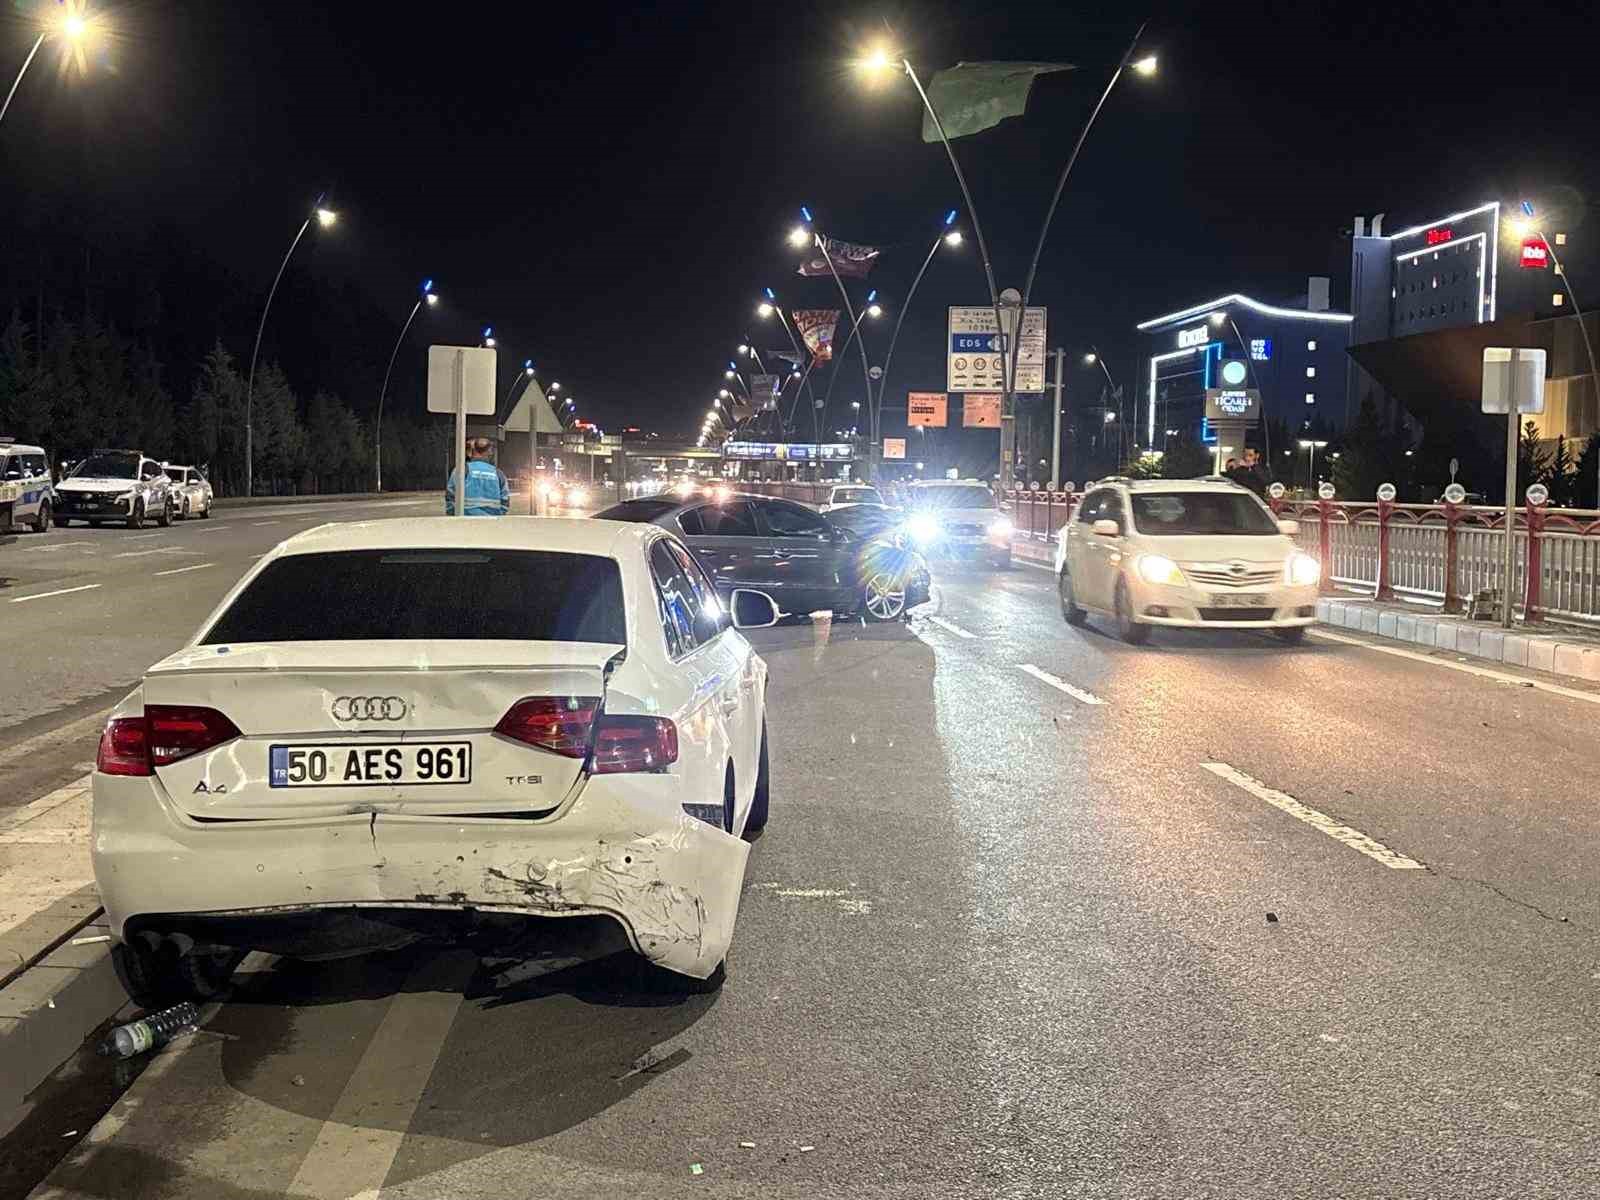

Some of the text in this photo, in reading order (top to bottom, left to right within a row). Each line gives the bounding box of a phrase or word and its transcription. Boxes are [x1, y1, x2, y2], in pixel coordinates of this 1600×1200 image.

[959, 339, 981, 347] EDS
[288, 747, 467, 782] 50 AES 961
